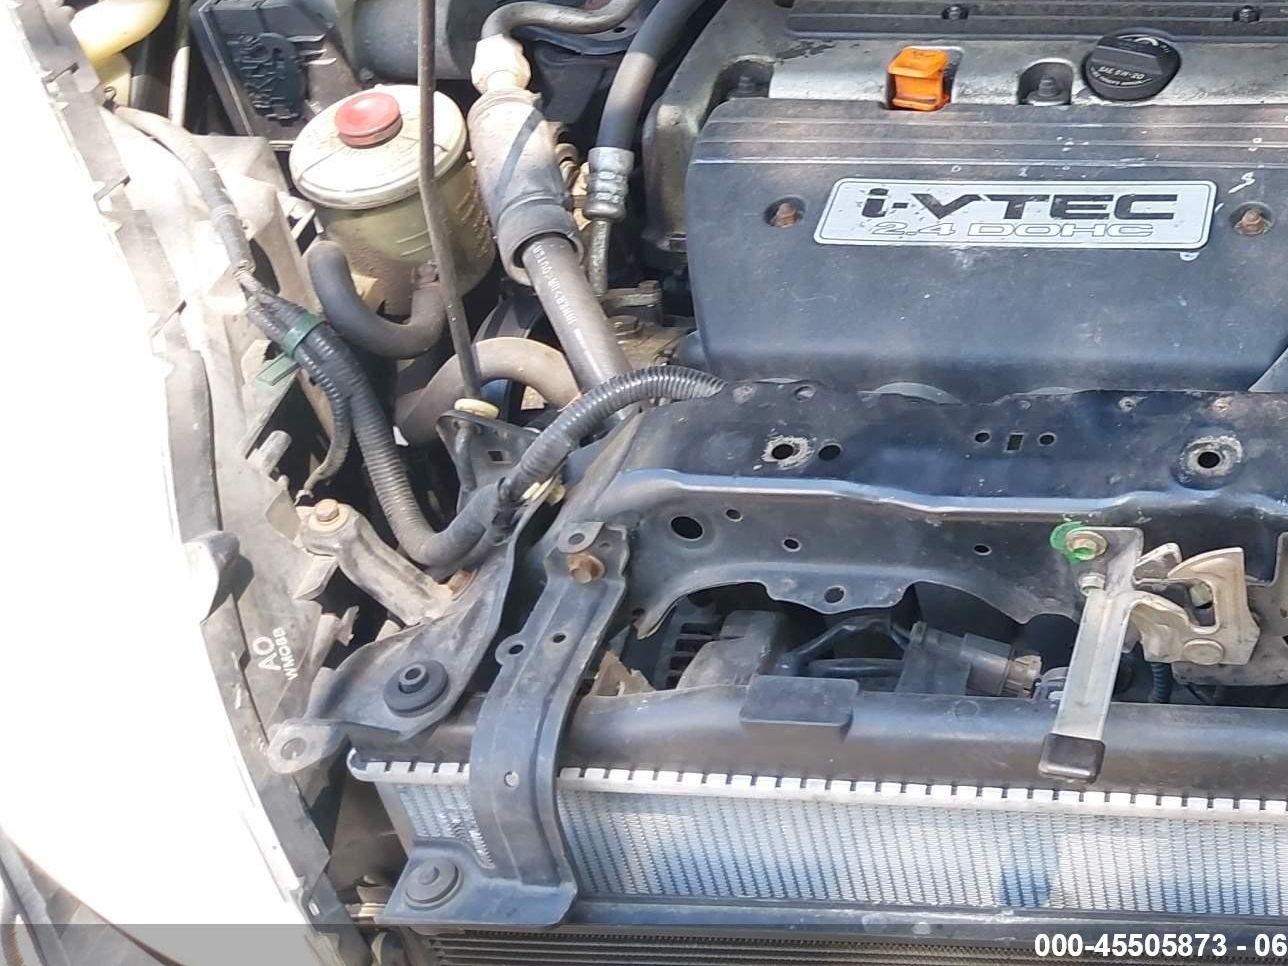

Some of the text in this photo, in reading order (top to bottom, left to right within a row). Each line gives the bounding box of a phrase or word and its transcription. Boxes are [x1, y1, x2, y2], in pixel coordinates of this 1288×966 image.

[861, 187, 1179, 220] i-VTEC
[871, 221, 1154, 238] 2.4 DOHC
